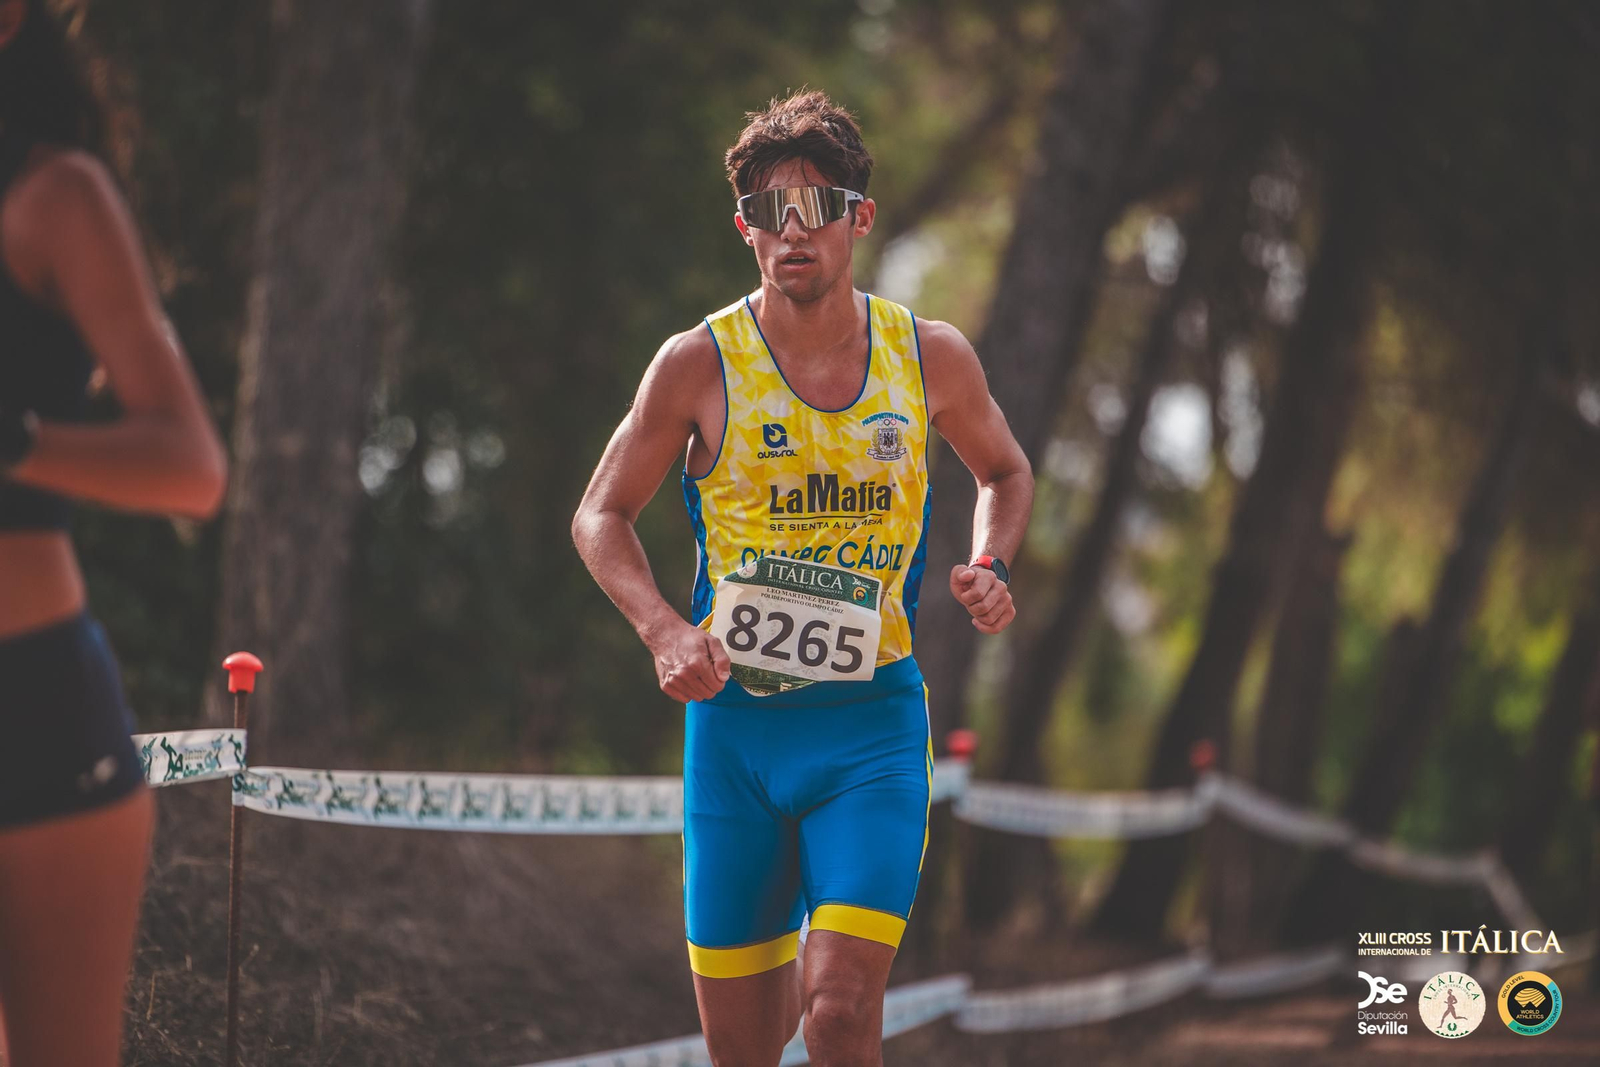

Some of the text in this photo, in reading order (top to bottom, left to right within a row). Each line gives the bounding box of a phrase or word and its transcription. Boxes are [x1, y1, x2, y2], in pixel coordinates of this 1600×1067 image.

[769, 523, 785, 531] SE
[789, 521, 829, 531] SIENTA
[832, 521, 841, 529] A
[844, 521, 858, 530] LA
[837, 535, 904, 571] CÁDIZ
[767, 563, 844, 590] ITÁLICA
[766, 587, 841, 607] LEO MARTINEZ PEREZ
[725, 604, 865, 674] 8265
